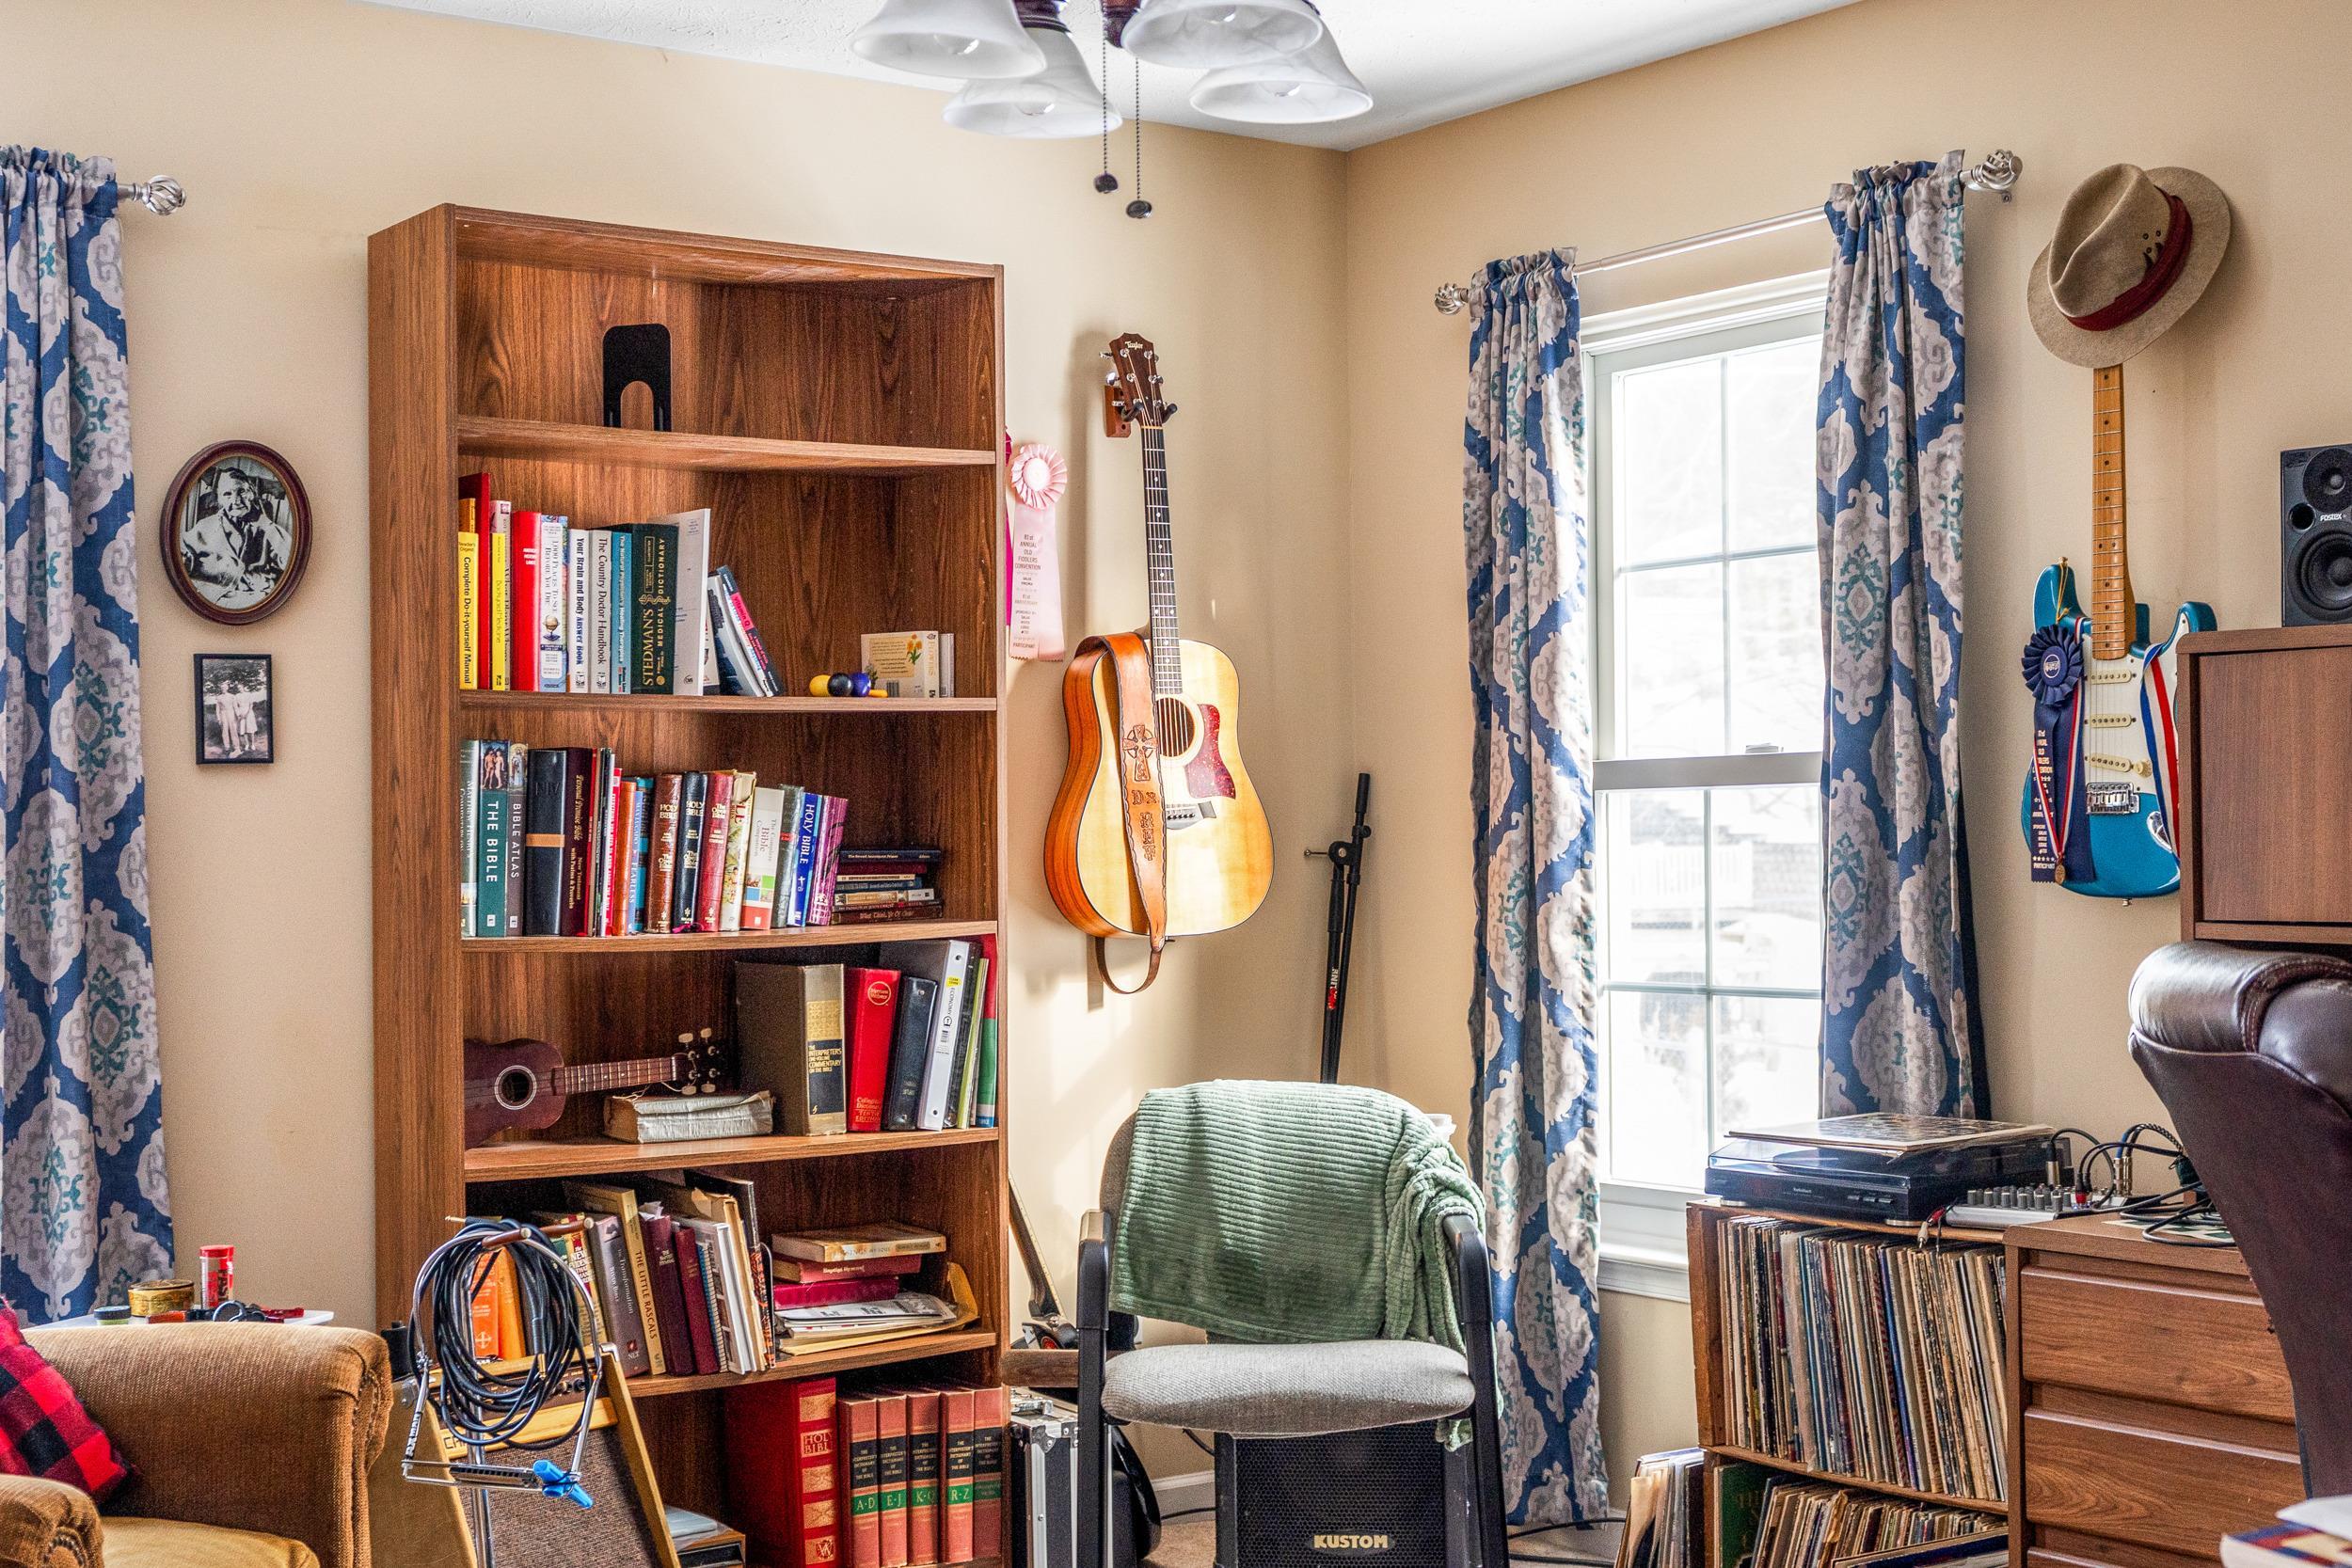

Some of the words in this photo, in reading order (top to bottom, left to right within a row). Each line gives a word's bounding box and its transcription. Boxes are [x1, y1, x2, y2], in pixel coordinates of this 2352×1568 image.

[1125, 341, 1143, 350] Taylor
[576, 538, 584, 555] Your
[598, 538, 608, 553] The
[463, 557, 471, 596] Complete
[576, 557, 584, 578] Brain
[596, 555, 608, 589] Country
[658, 538, 666, 594] DICTIONARY
[575, 596, 584, 615] Body
[597, 591, 608, 619] Doctor
[463, 597, 471, 651] Do-it-yourself
[617, 608, 626, 631] Healing
[576, 645, 584, 666] Book
[597, 620, 608, 665] Handbook
[617, 632, 626, 664] Therapies
[643, 609, 654, 687] STEDMAN'S
[464, 652, 472, 685] Manual
[575, 774, 584, 801] Personal
[486, 800, 499, 830] THE
[512, 803, 521, 836] BIBLE
[574, 800, 583, 824] Promise
[660, 811, 677, 819] BIBLE
[685, 809, 704, 817] BIBLE
[686, 801, 704, 810] HOLY
[803, 803, 815, 833] HOLY
[573, 824, 583, 841] Bible
[754, 819, 762, 857] Companion
[760, 827, 770, 852] Bible
[486, 838, 499, 882] BIBLE
[511, 842, 520, 879] ATLAS
[768, 832, 776, 862] Complete
[800, 834, 812, 864] BIBLE
[629, 862, 638, 903] FEARLESS
[947, 988, 957, 1016] ECONOMY
[809, 1060, 841, 1069] COMMENTARY
[635, 1249, 644, 1268] THE
[620, 1259, 634, 1315] Transformation
[639, 1270, 651, 1299] LITTLE
[644, 1300, 658, 1340] RASCALS
[628, 1351, 641, 1360] NLT
[1313, 1534, 1389, 1549] KUSTOM
